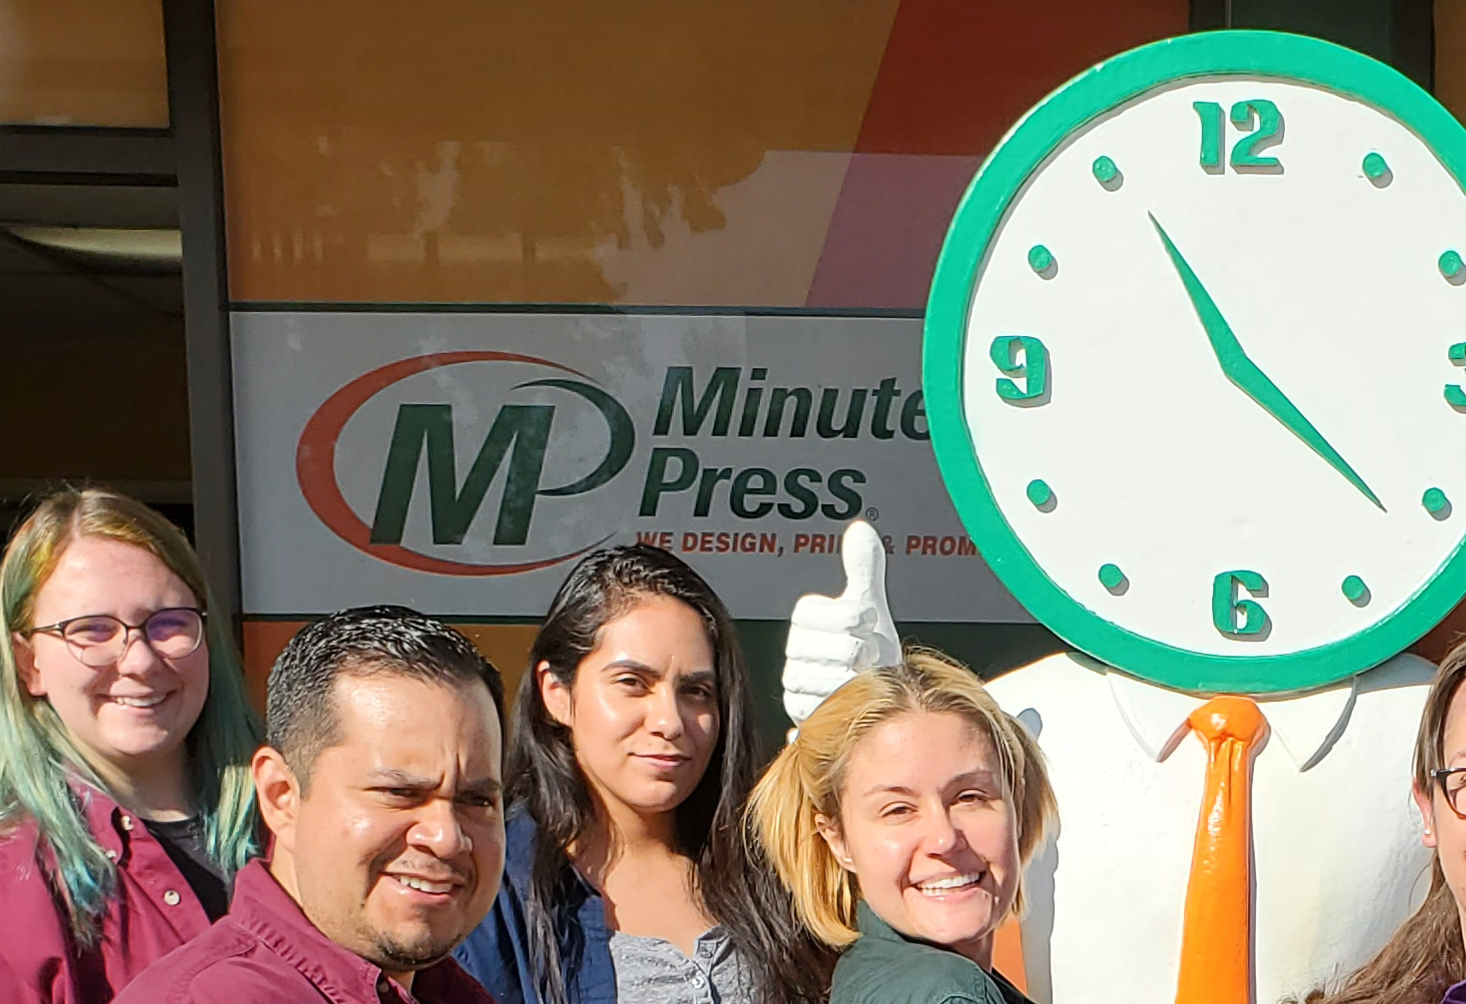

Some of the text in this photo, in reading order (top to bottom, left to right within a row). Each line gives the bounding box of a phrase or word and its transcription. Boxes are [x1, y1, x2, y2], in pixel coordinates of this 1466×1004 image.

[1193, 99, 1285, 174] 12
[990, 335, 1051, 407] 9
[681, 533, 785, 558] DESIGN,
[793, 533, 844, 554] PRI
[1212, 570, 1272, 642] 6
